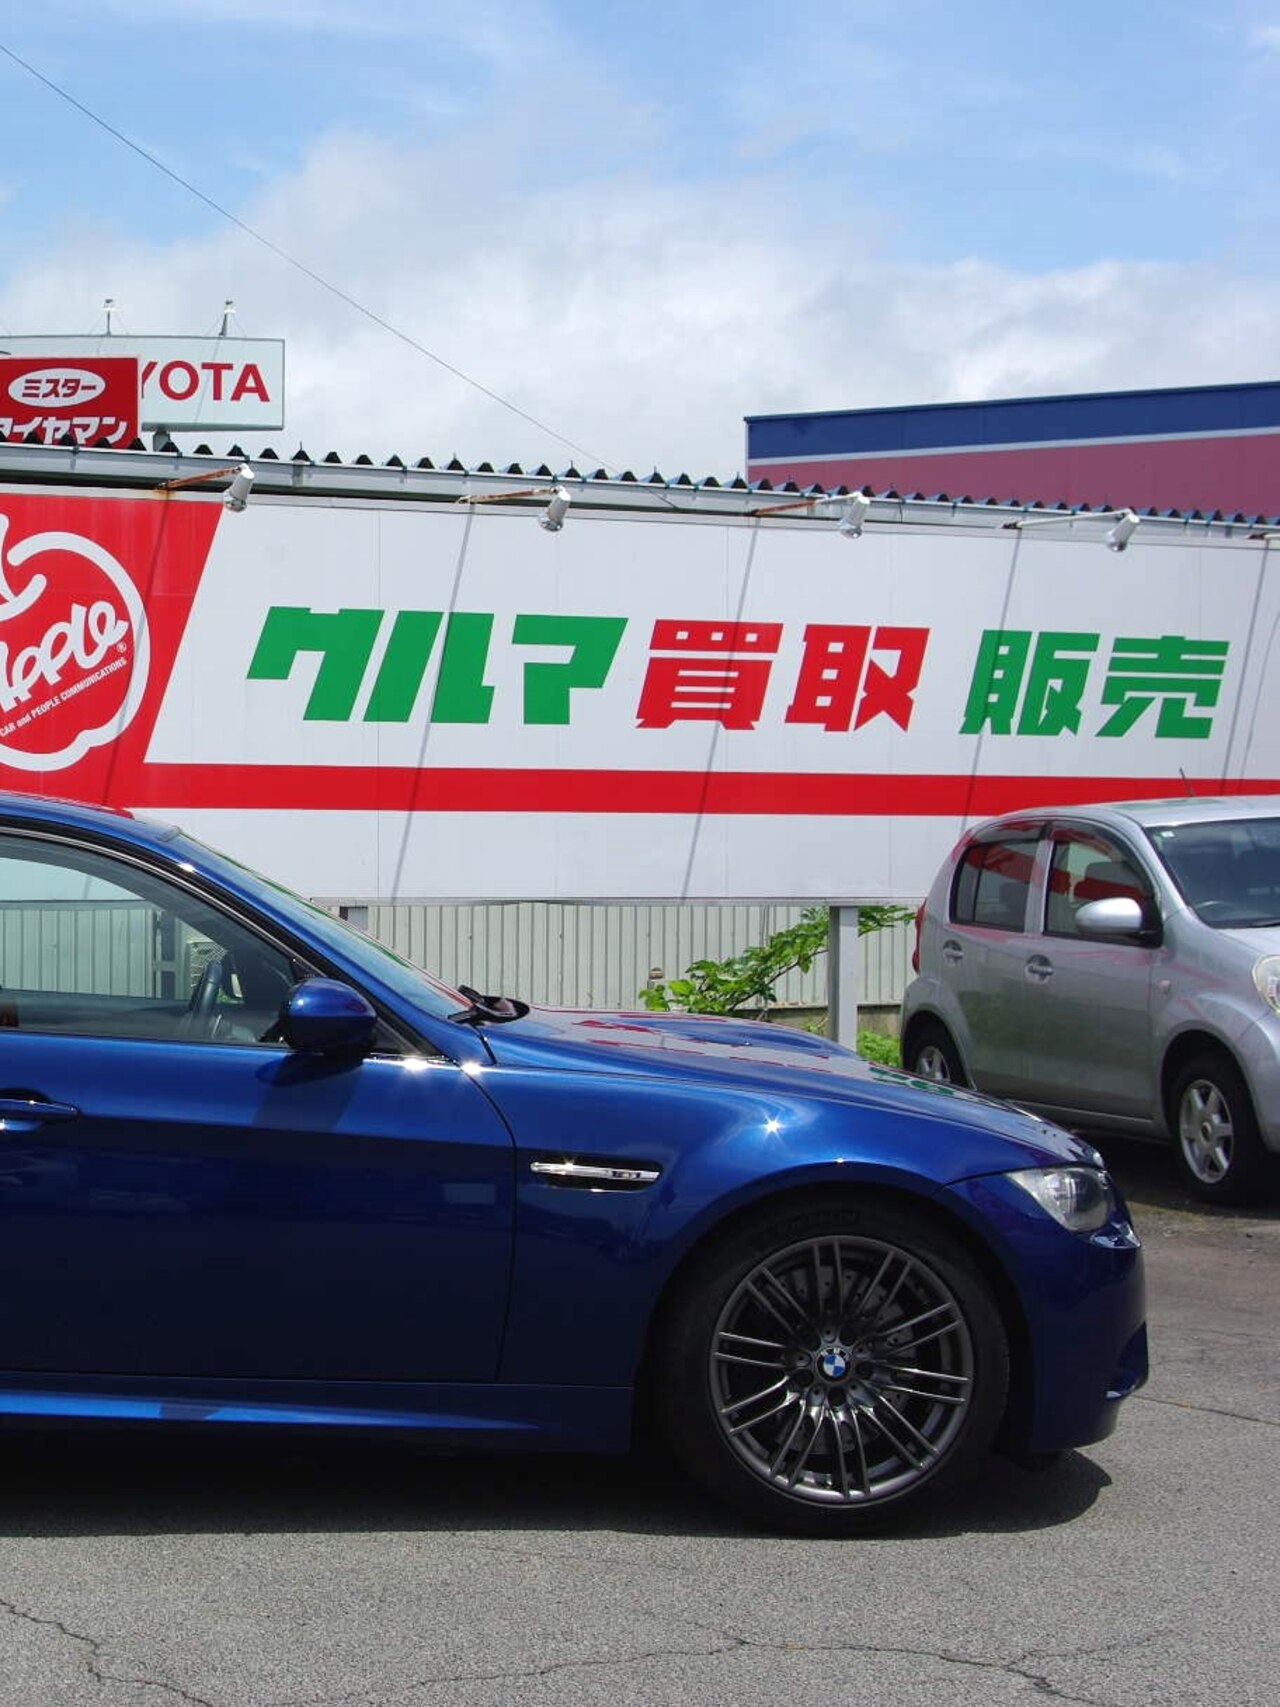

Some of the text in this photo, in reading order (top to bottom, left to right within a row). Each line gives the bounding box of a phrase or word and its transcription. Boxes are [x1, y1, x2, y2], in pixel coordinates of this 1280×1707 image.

[22, 379, 97, 399] ミスター
[0, 656, 127, 737] CAR and PEOPLE COMMUNICATIONS
